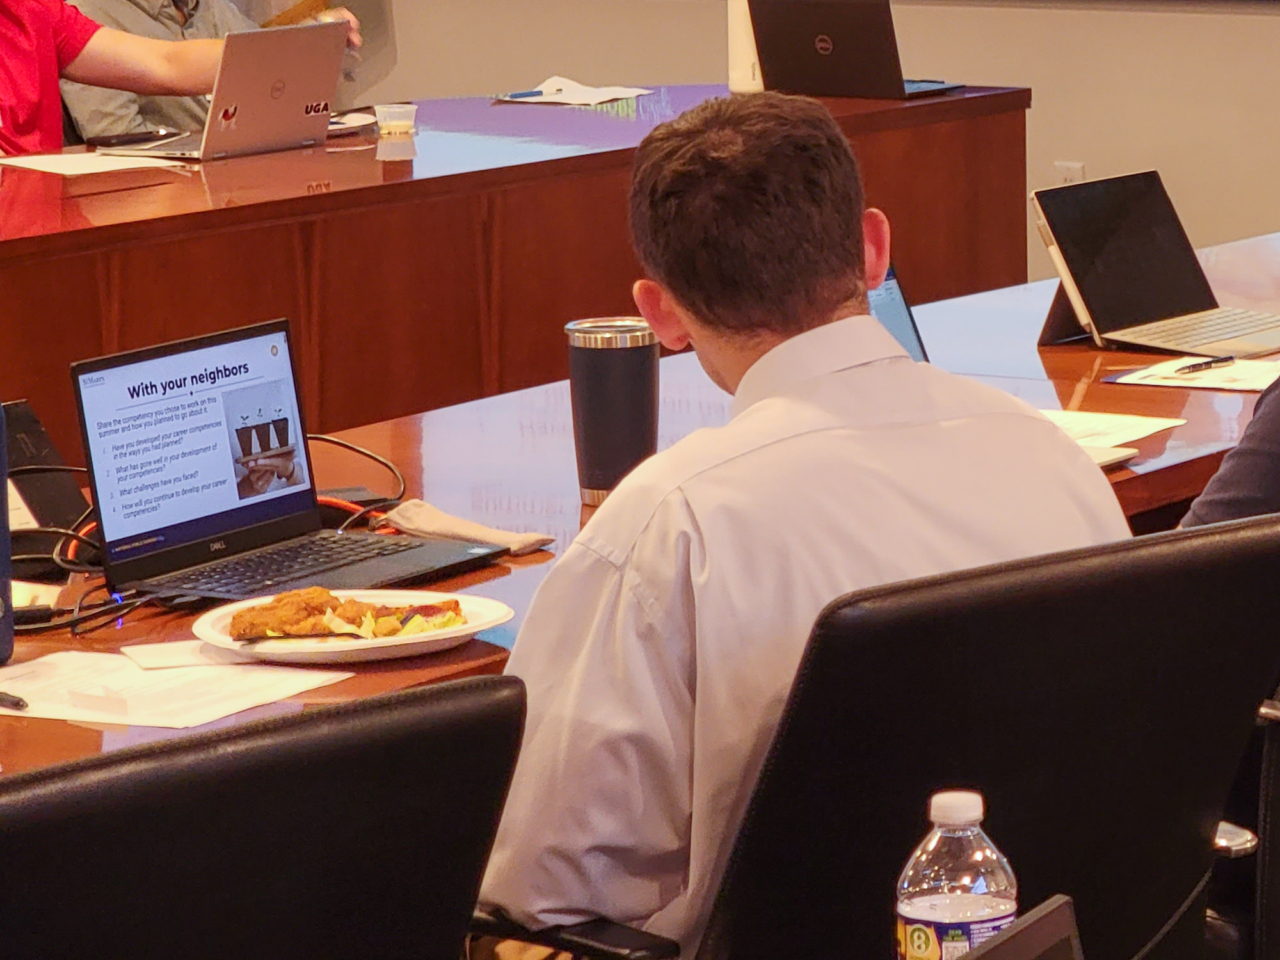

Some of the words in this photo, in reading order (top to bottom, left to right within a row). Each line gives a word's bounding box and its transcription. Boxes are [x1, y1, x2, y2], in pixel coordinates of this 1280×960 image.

[304, 101, 330, 116] UGA
[127, 380, 159, 400] With
[159, 376, 188, 396] your
[190, 363, 250, 386] neighbors
